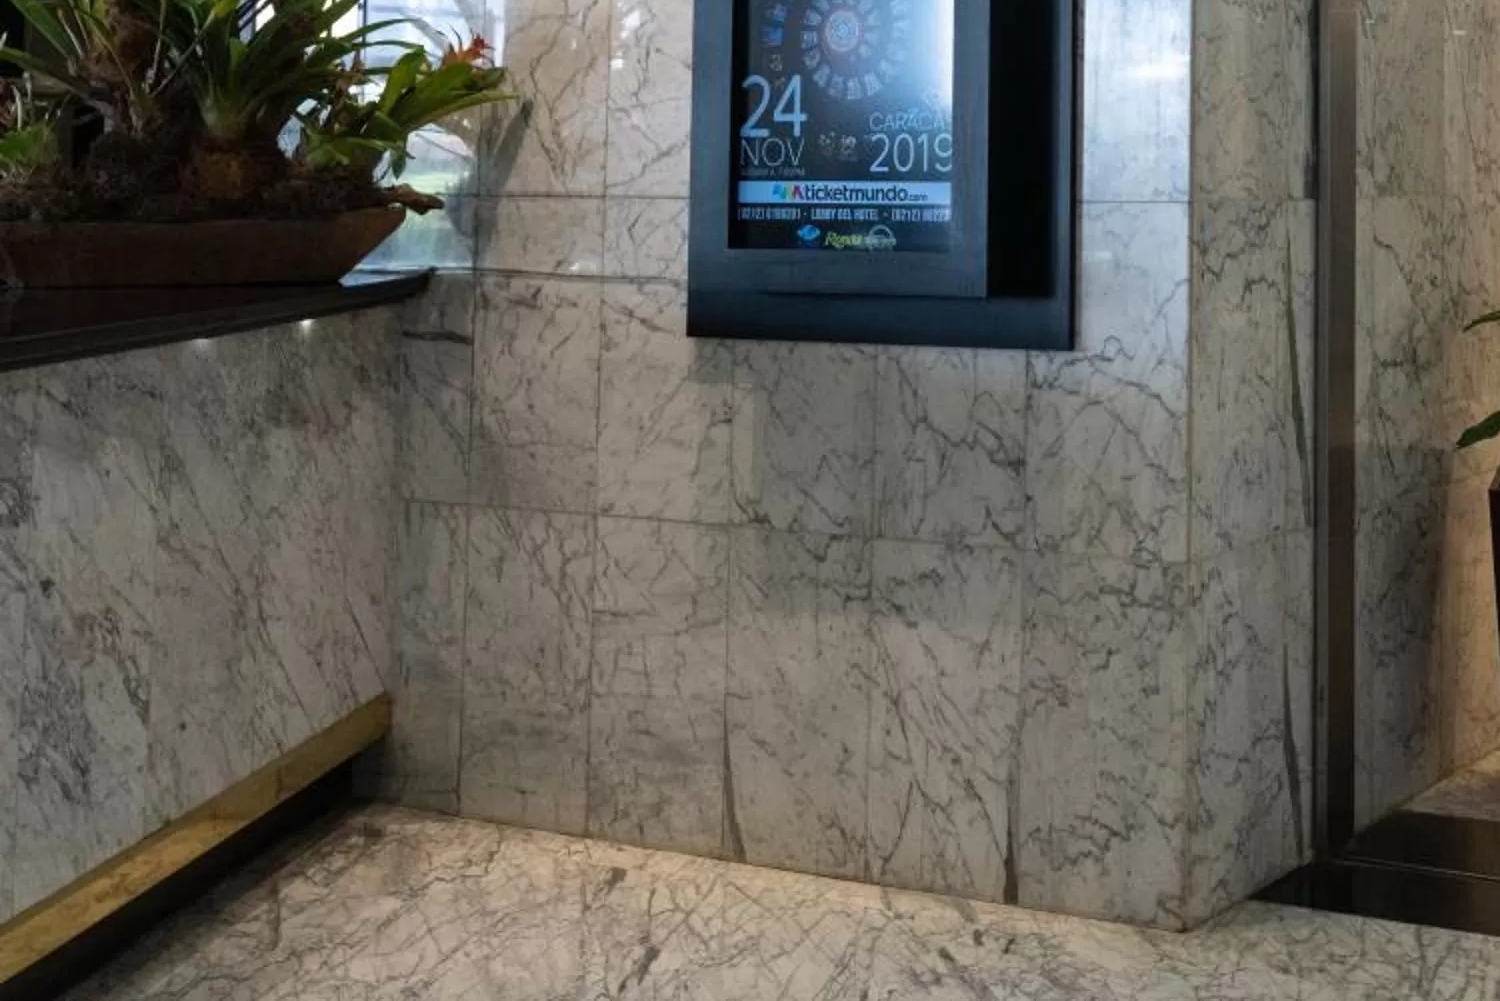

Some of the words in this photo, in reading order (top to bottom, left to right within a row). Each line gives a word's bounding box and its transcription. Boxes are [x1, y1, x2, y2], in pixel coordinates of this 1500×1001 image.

[739, 74, 808, 138] 24
[740, 137, 806, 167] NOV
[869, 133, 953, 173] 2019
